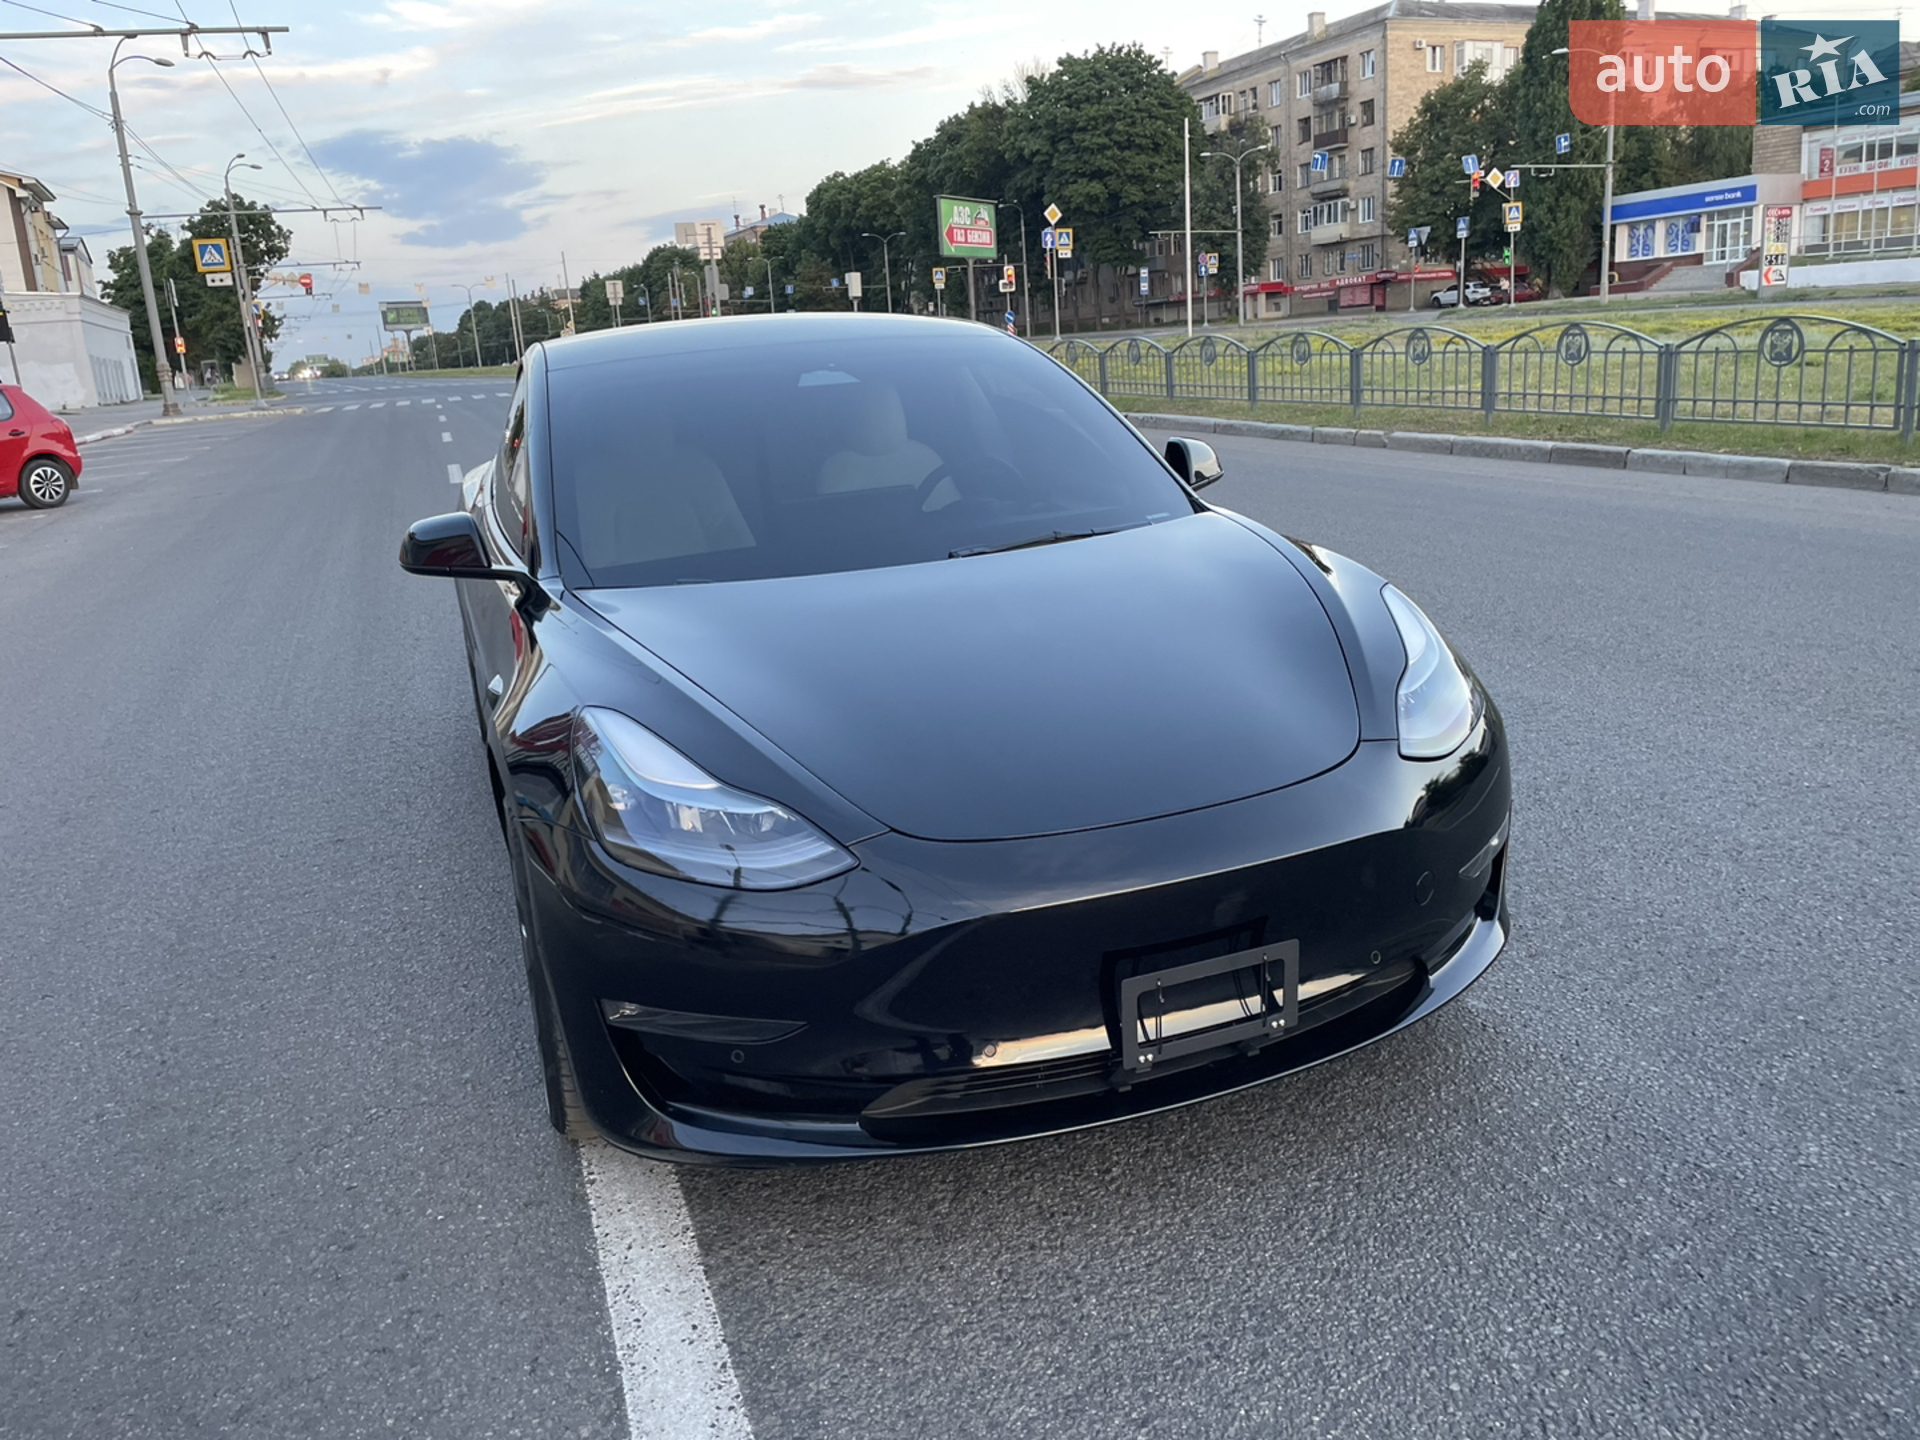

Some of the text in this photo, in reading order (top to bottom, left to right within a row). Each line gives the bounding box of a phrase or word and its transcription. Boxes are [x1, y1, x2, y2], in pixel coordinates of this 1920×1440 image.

[1725, 190, 1741, 200] bank
[953, 205, 971, 225] АЗС
[953, 229, 966, 243] ГАЗ
[1336, 275, 1366, 286] АДВОКАТ
